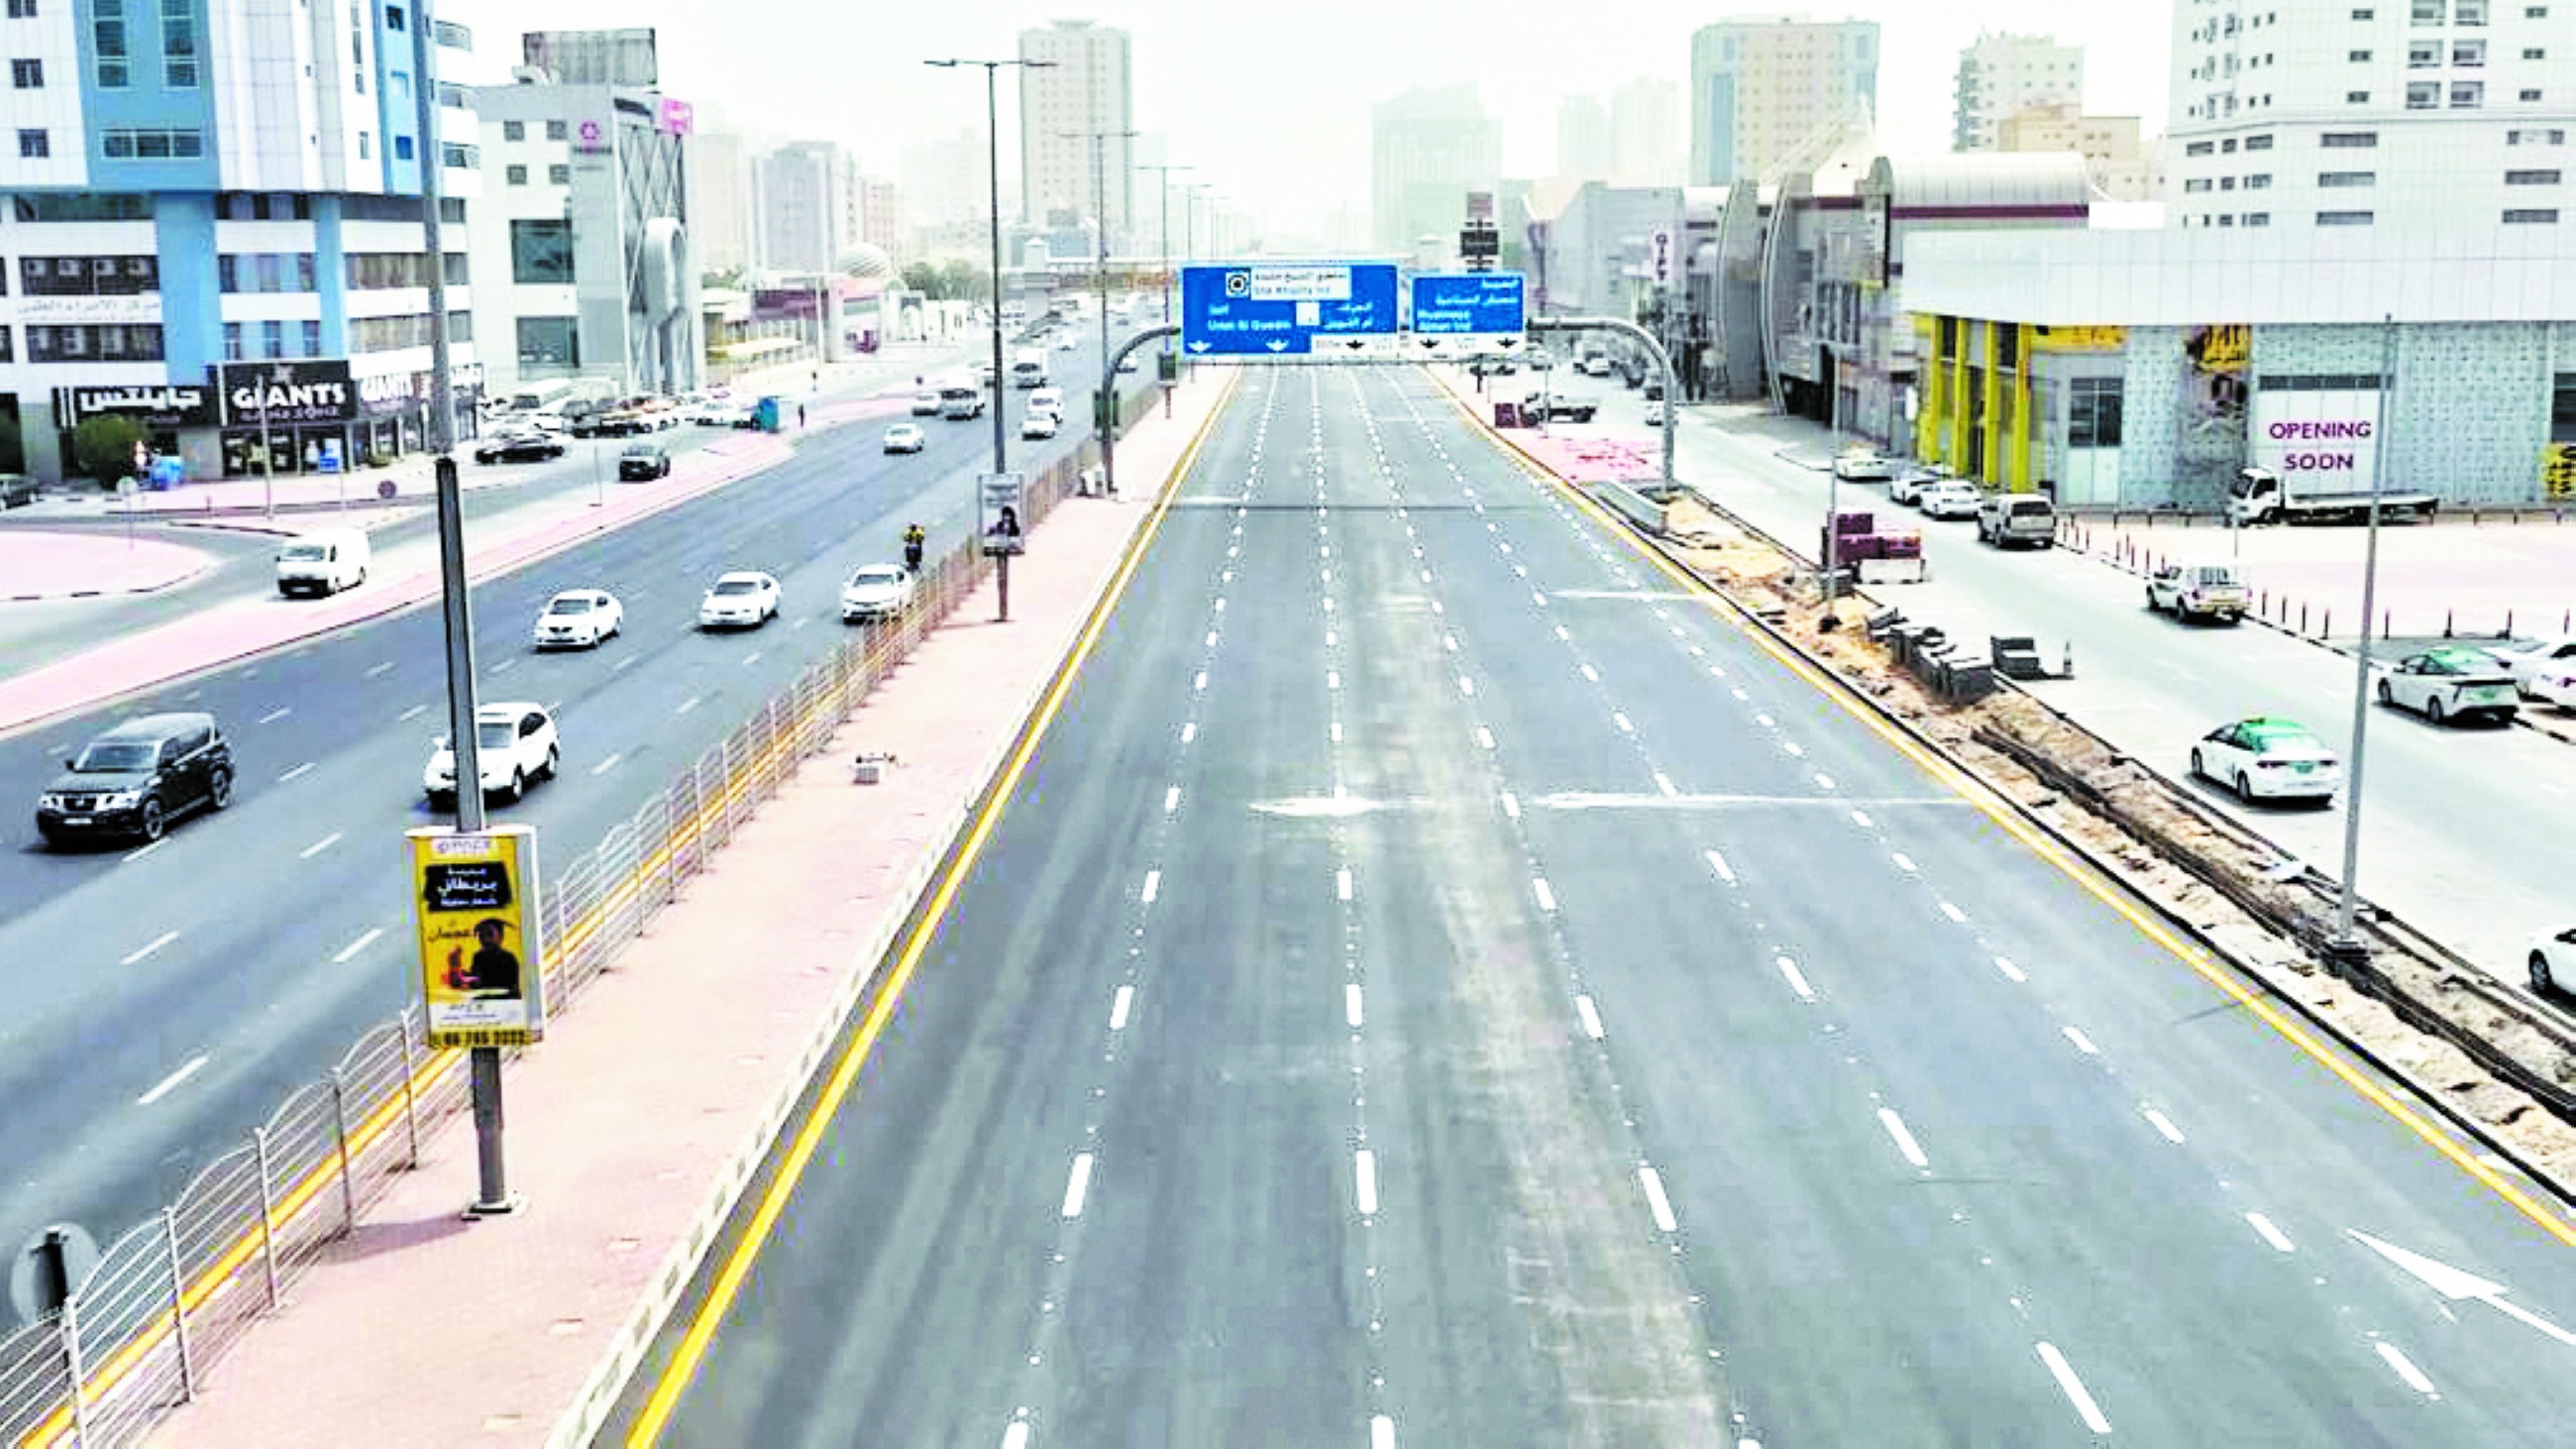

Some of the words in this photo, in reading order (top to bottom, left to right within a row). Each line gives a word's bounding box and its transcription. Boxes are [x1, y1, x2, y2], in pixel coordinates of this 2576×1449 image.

[232, 383, 347, 410] GIANTS
[2269, 421, 2371, 440] OPENING
[2284, 453, 2354, 471] SOON
